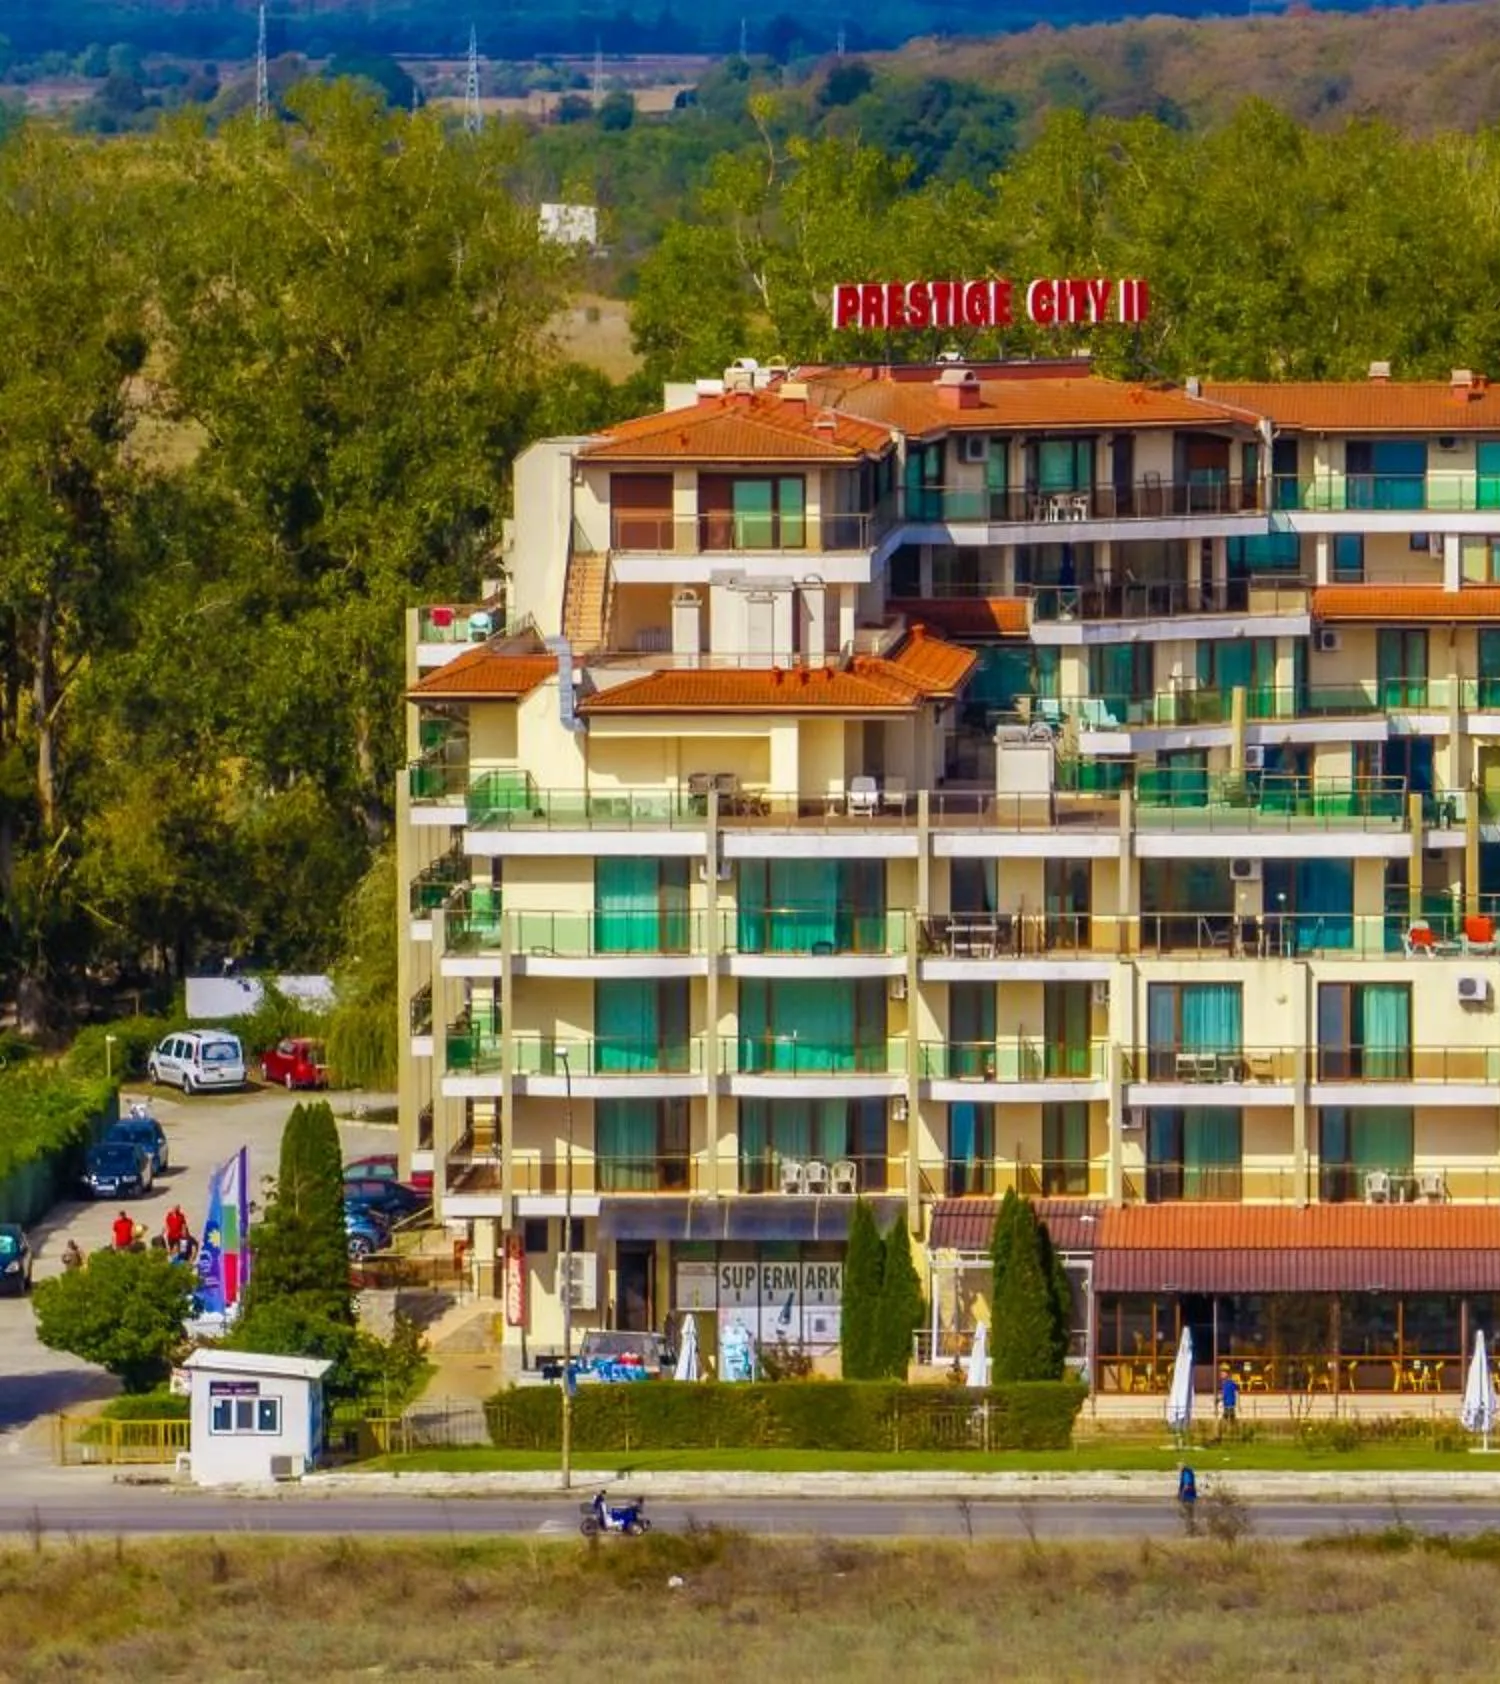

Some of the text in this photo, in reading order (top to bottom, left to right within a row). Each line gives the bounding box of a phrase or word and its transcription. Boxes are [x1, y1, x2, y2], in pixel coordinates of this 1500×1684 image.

[833, 279, 1148, 328] PRESTIGE CITY II
